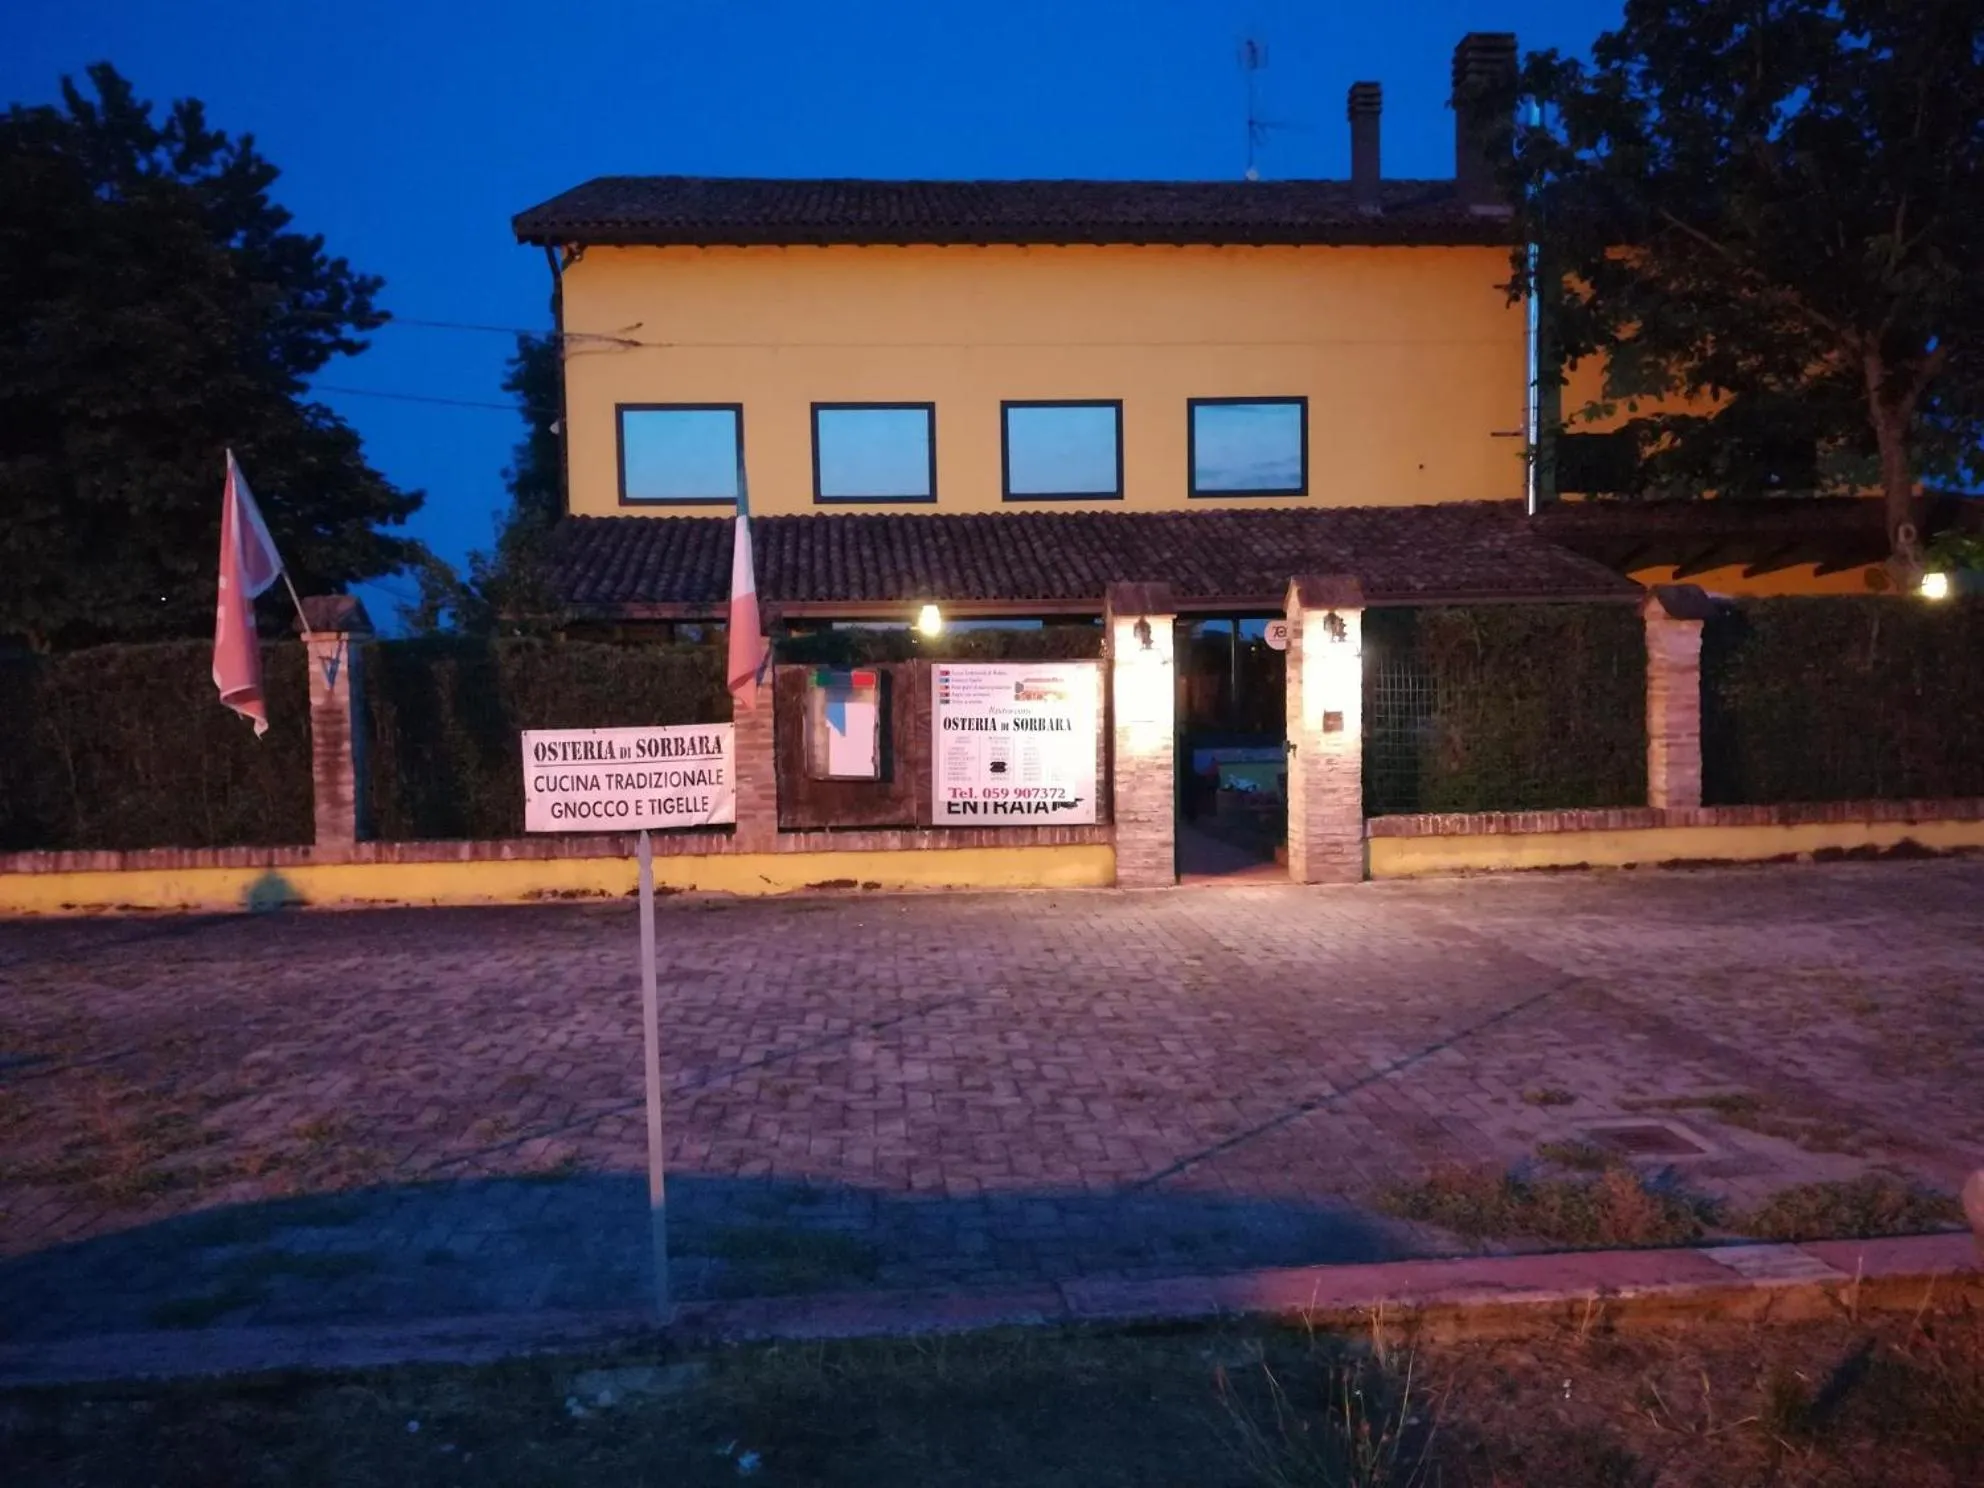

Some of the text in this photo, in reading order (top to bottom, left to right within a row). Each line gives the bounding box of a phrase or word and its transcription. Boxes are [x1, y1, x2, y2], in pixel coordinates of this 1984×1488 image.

[943, 717, 1072, 732] OSTERIA DI SORBARA
[533, 735, 723, 762] OSTERIA DI SORBARA
[534, 769, 724, 793] CUCINA TRADIZIONALE
[947, 787, 1066, 799] Tel. 059 907372
[551, 796, 709, 819] GNOCCO E TIGELLE
